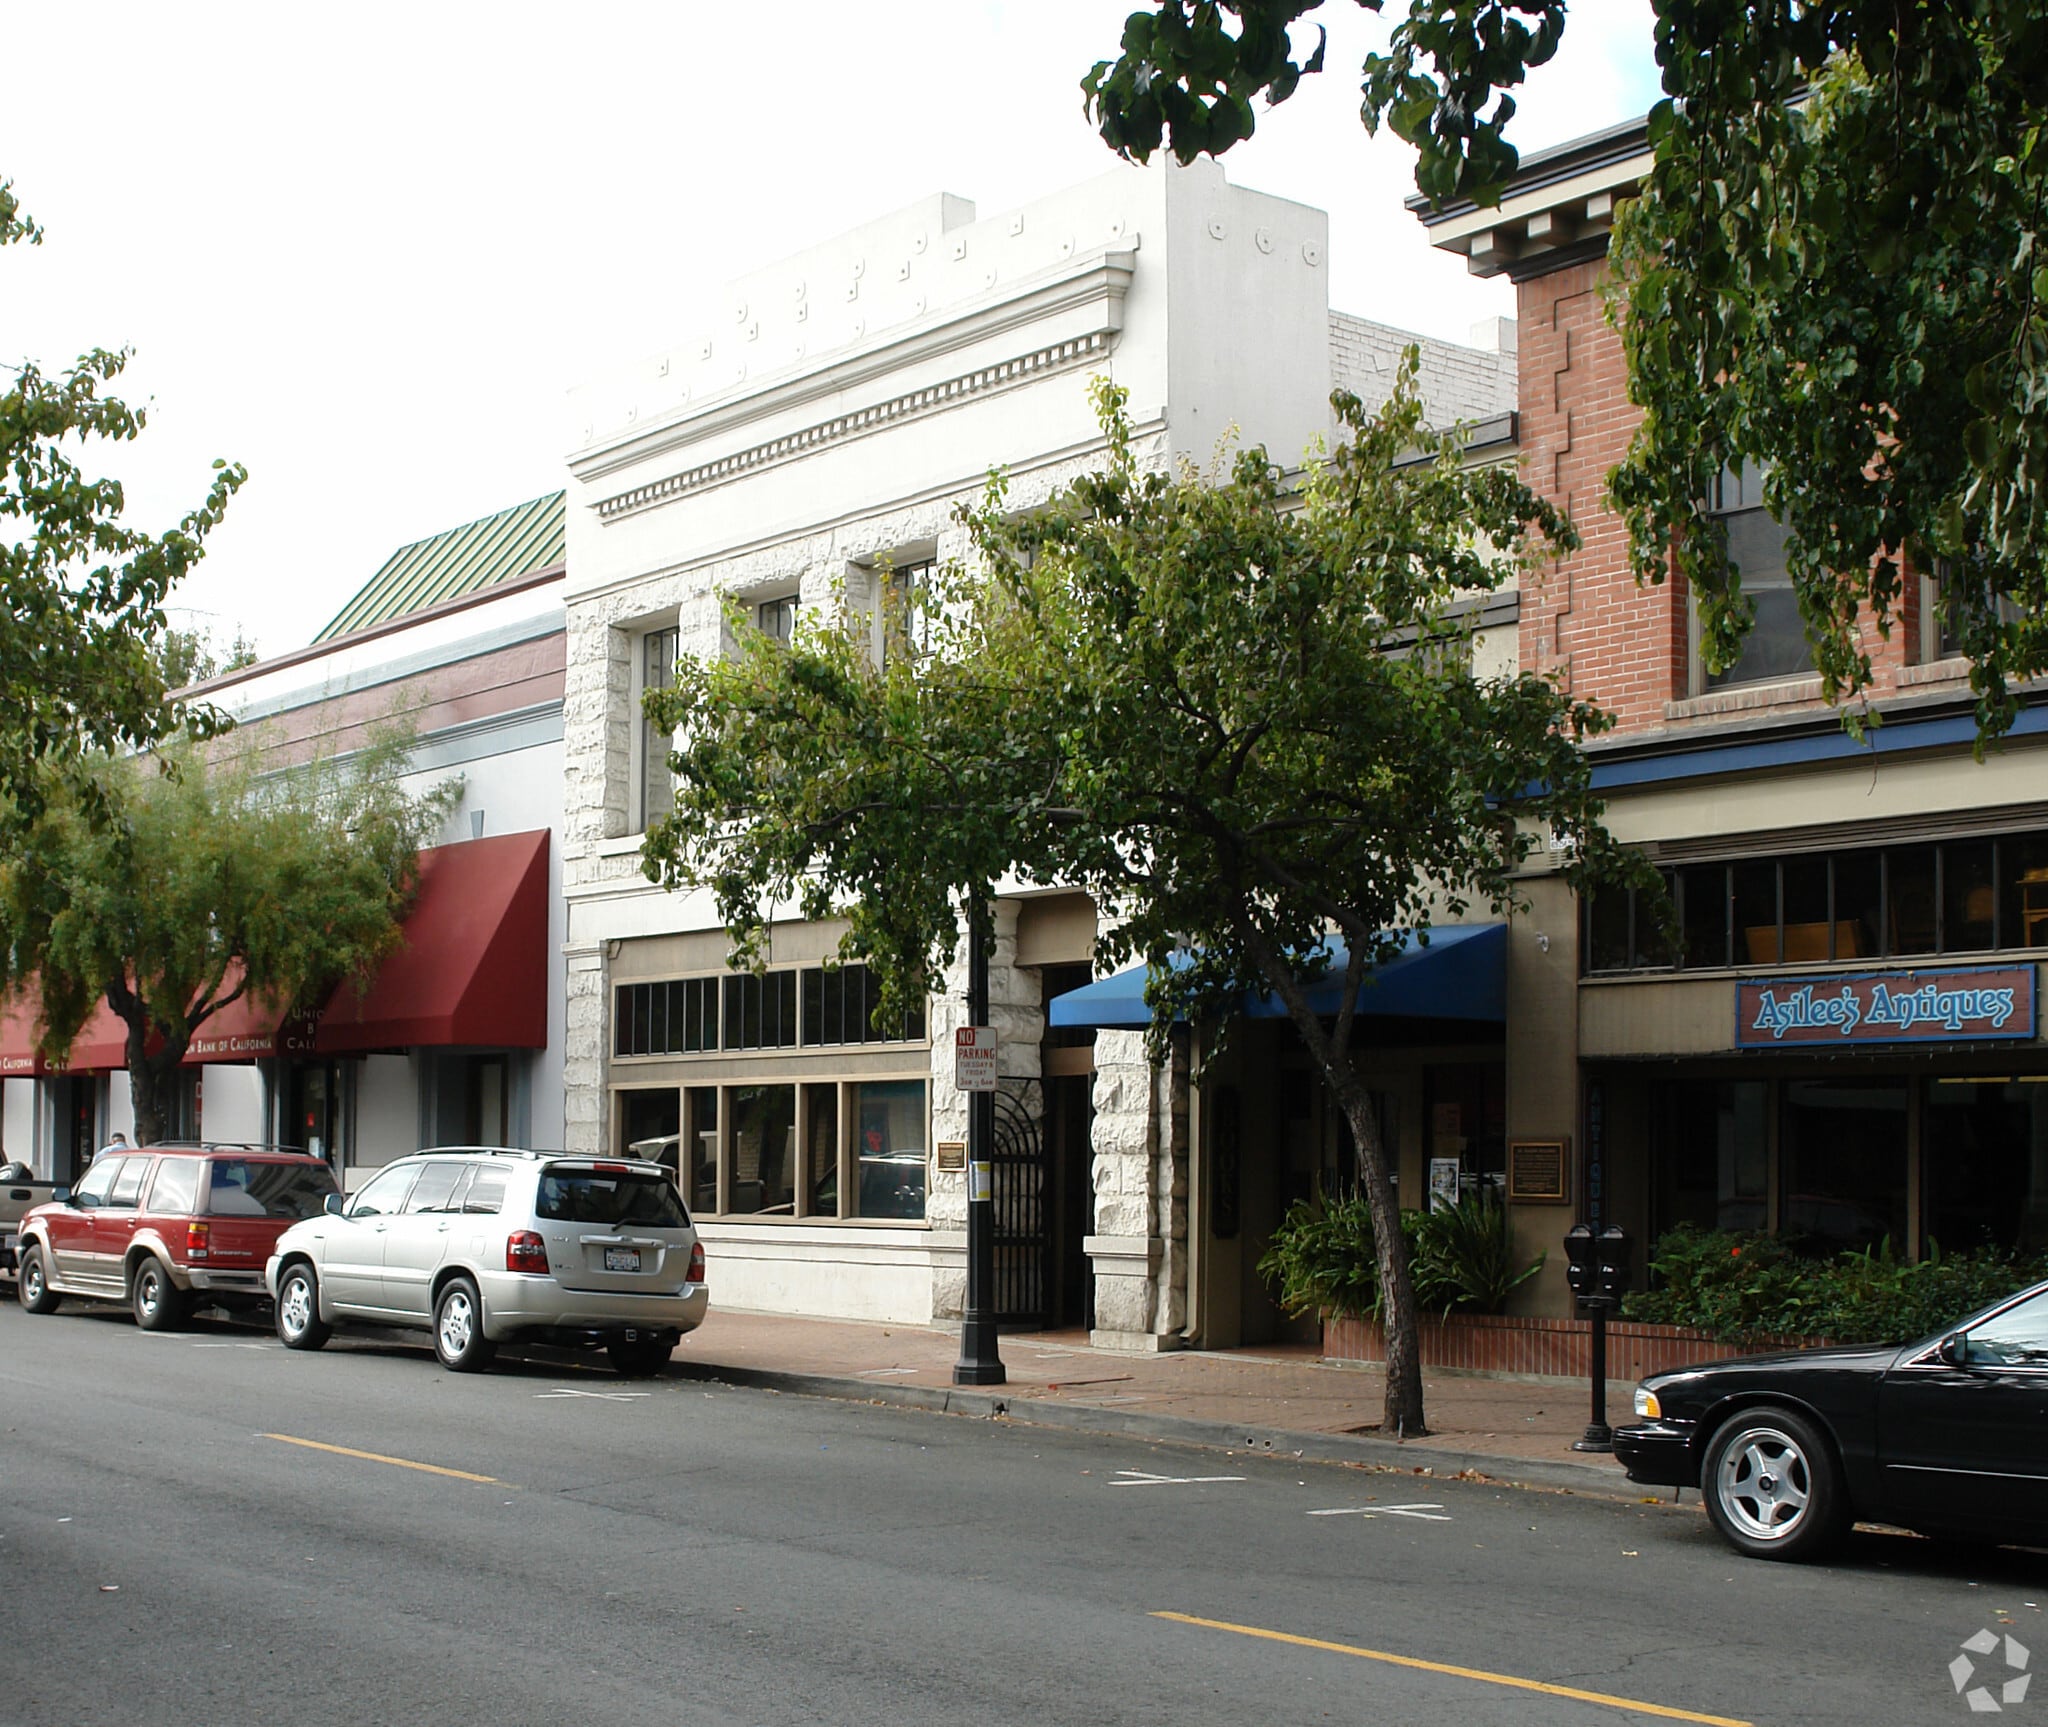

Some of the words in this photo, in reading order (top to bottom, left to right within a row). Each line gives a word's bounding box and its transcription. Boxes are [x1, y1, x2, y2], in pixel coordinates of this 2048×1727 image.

[1753, 984, 1861, 1039] Asilee's
[1864, 982, 2015, 1030] Antiques
[959, 1030, 973, 1044] NO
[958, 1048, 995, 1060] PARKING
